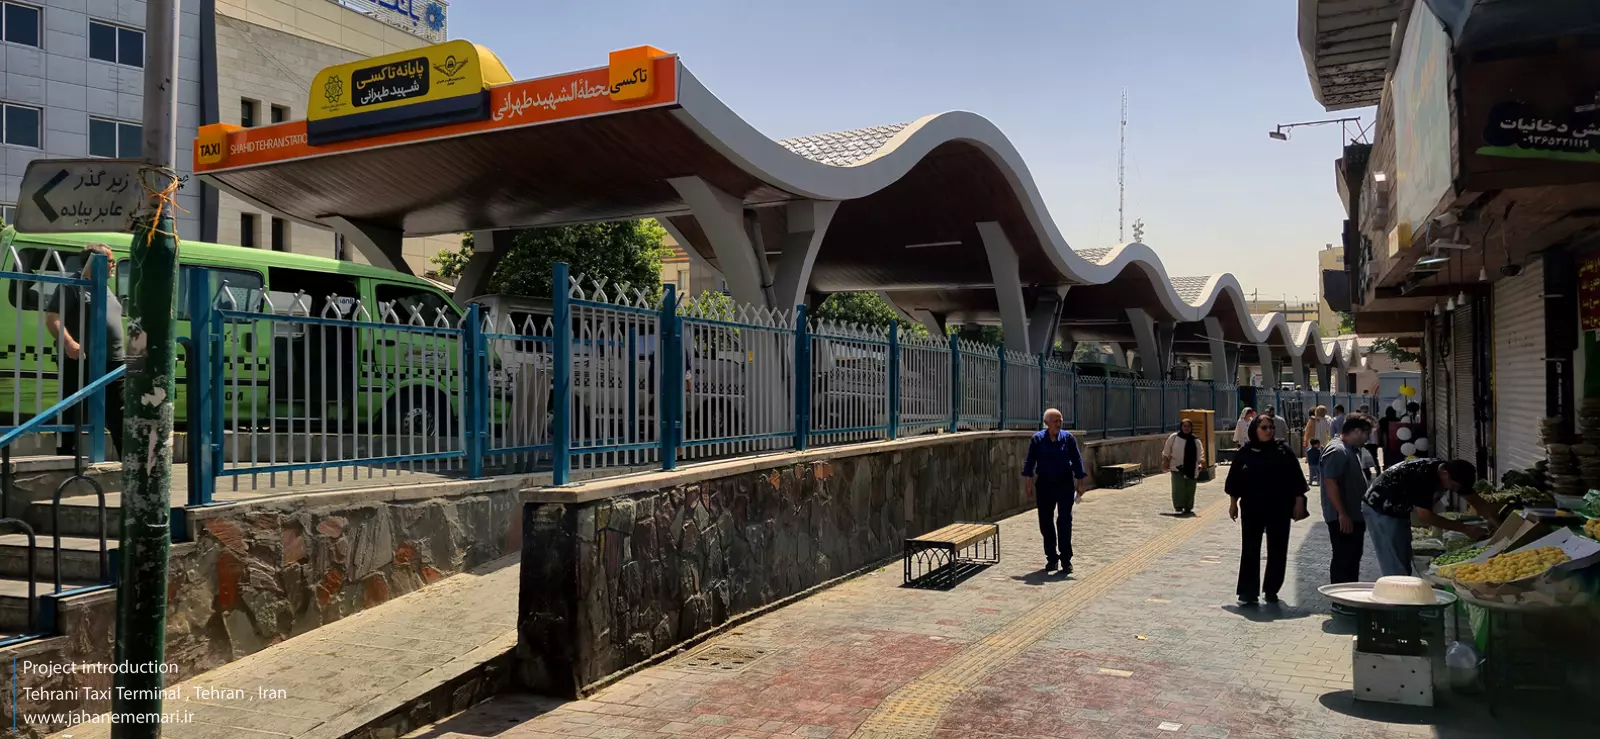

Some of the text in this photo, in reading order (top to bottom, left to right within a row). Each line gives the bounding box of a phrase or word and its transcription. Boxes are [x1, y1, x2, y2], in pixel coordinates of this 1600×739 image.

[356, 60, 425, 90] پایانه تاکسی
[609, 67, 648, 94] تاکسی
[360, 85, 390, 105] طهرانی
[390, 80, 420, 97] شهید
[1500, 117, 1568, 134] دخانیات
[200, 142, 220, 157] TAXI
[255, 138, 285, 152] TEHRANI
[285, 133, 308, 147] STATIO
[73, 169, 130, 194] زیر گذر
[60, 200, 123, 225] عابر پیاده
